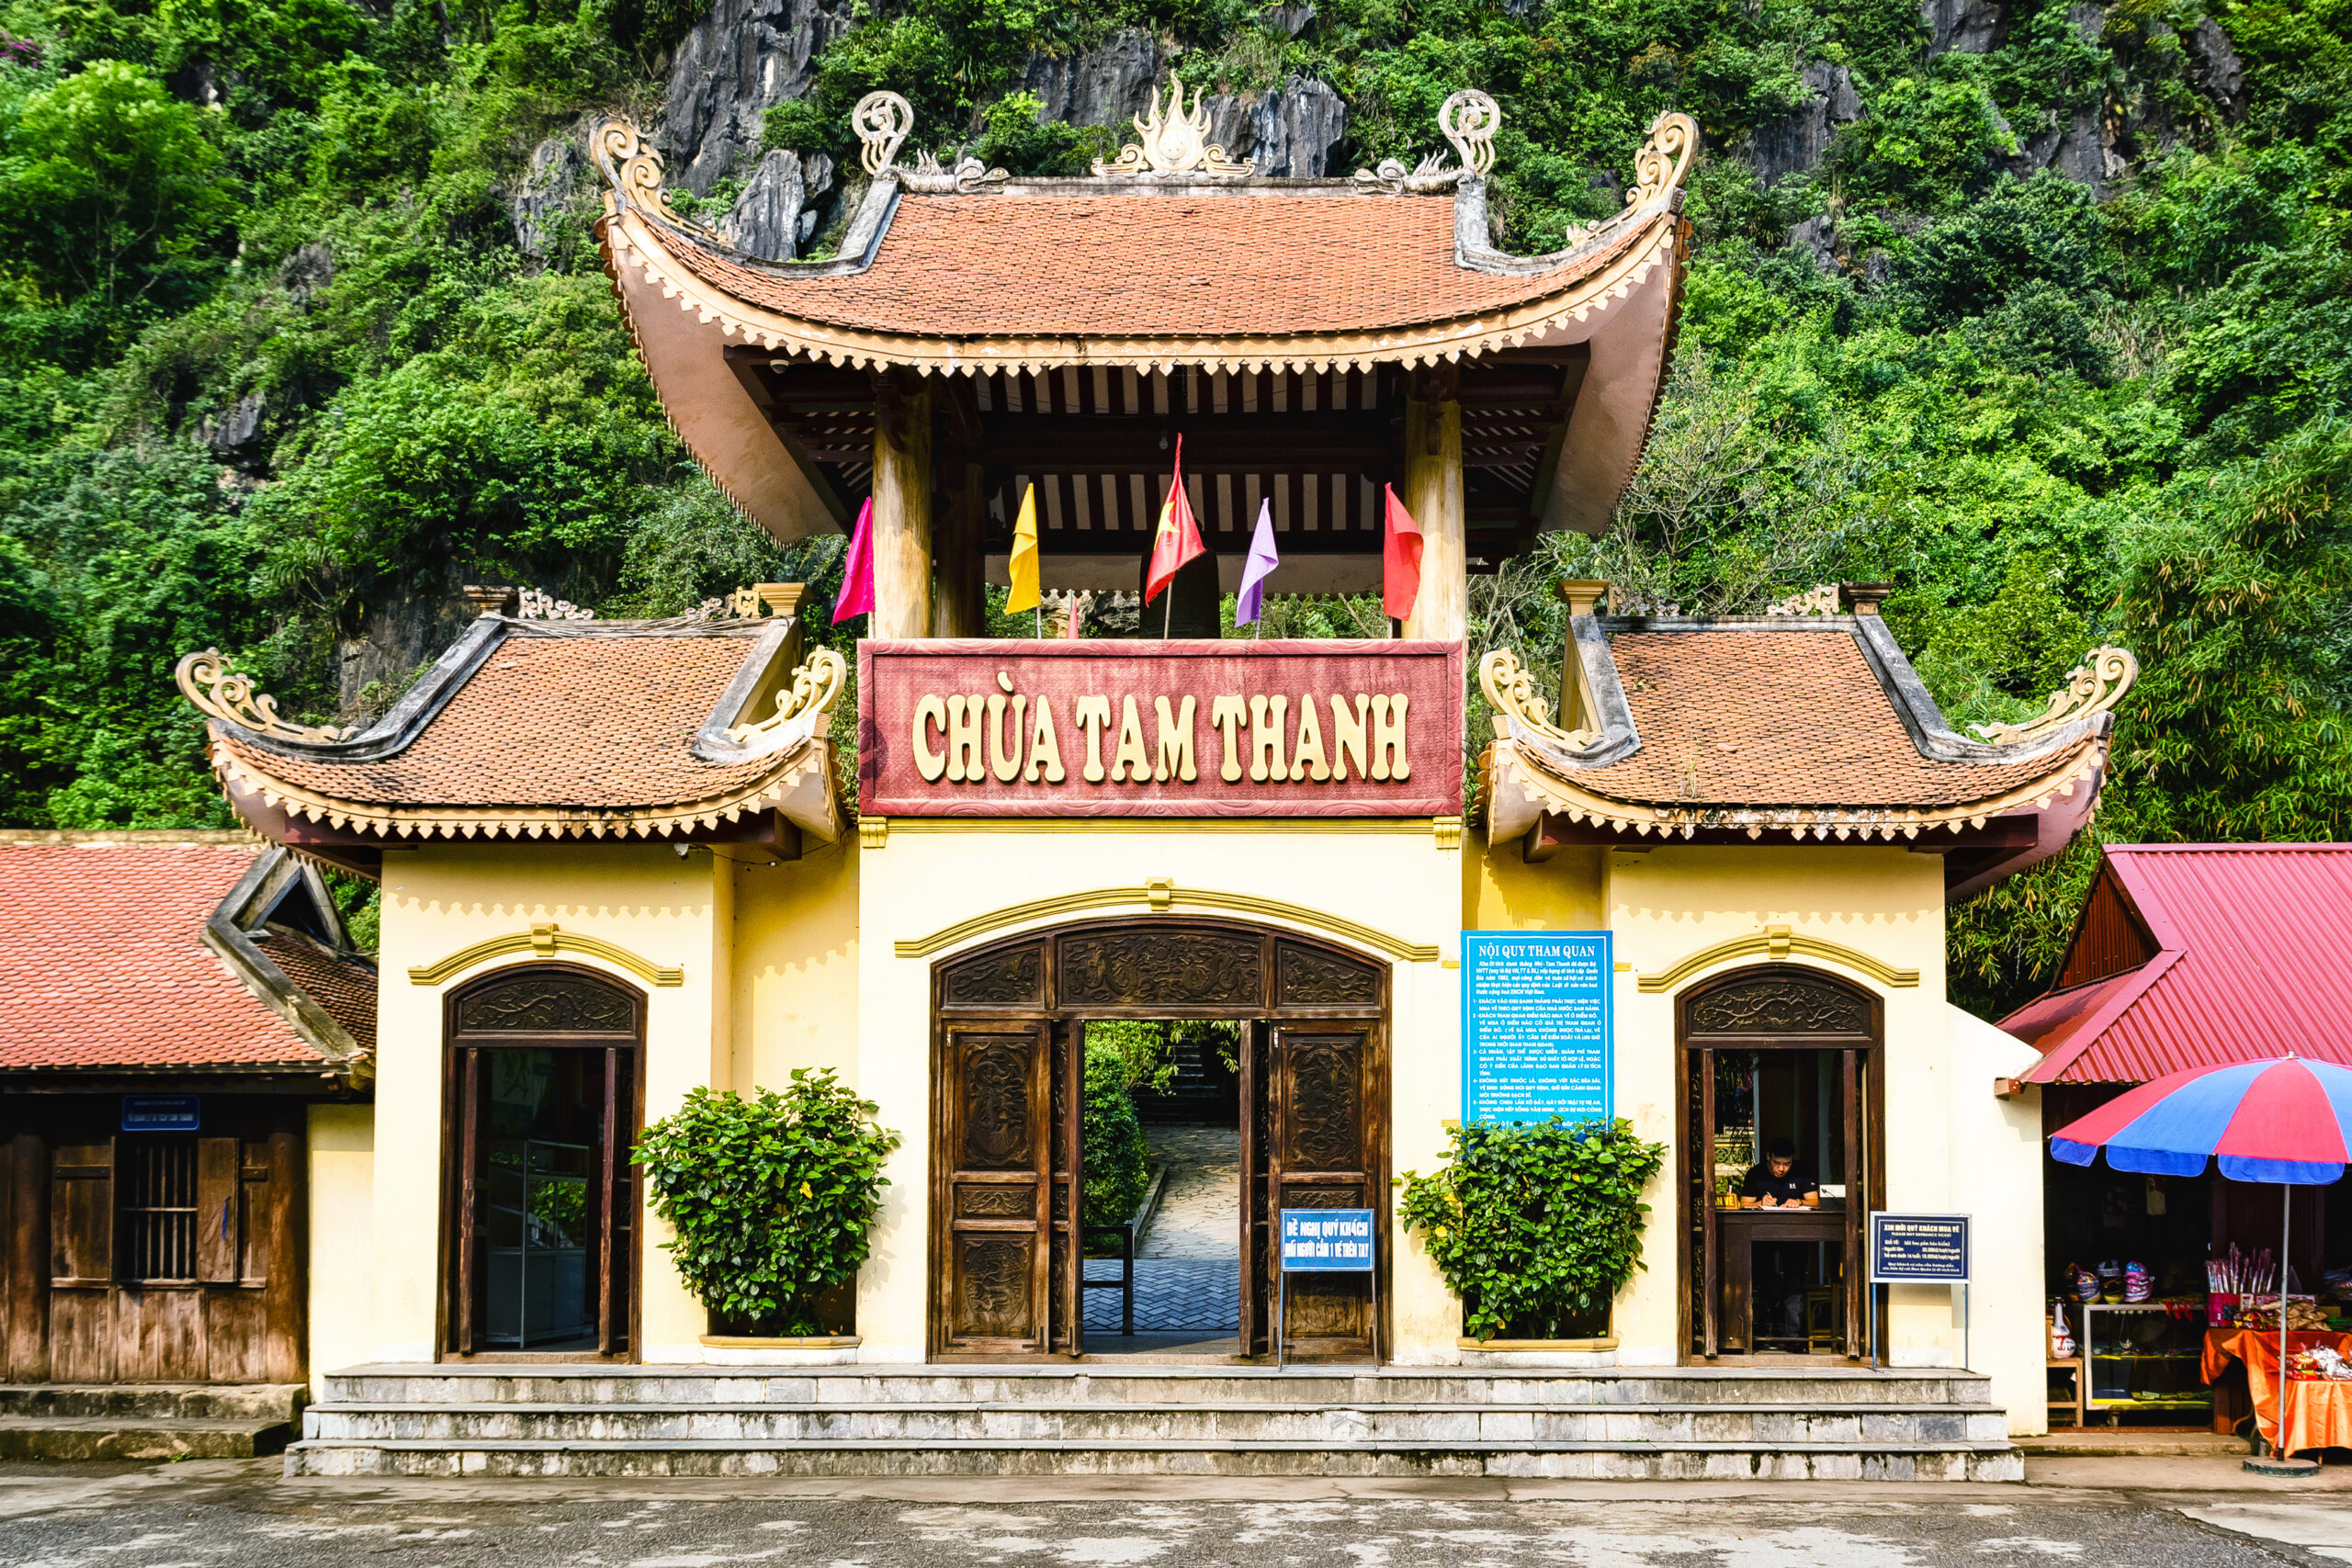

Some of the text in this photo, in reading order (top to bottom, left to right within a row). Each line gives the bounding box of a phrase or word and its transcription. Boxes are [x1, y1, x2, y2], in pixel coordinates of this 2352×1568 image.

[912, 671, 1410, 784] CHÙA TAM THANH
[1479, 942, 1595, 959] NỘI QUY THAM QUAN
[1287, 1218, 1368, 1239] ĐỀ NGHỊ QUÝ KHÁCH
[1330, 1243, 1333, 1257] 1
[1335, 1240, 1342, 1257] VÉ
[1343, 1240, 1357, 1257] TRÊN
[1358, 1243, 1369, 1257] TAY
